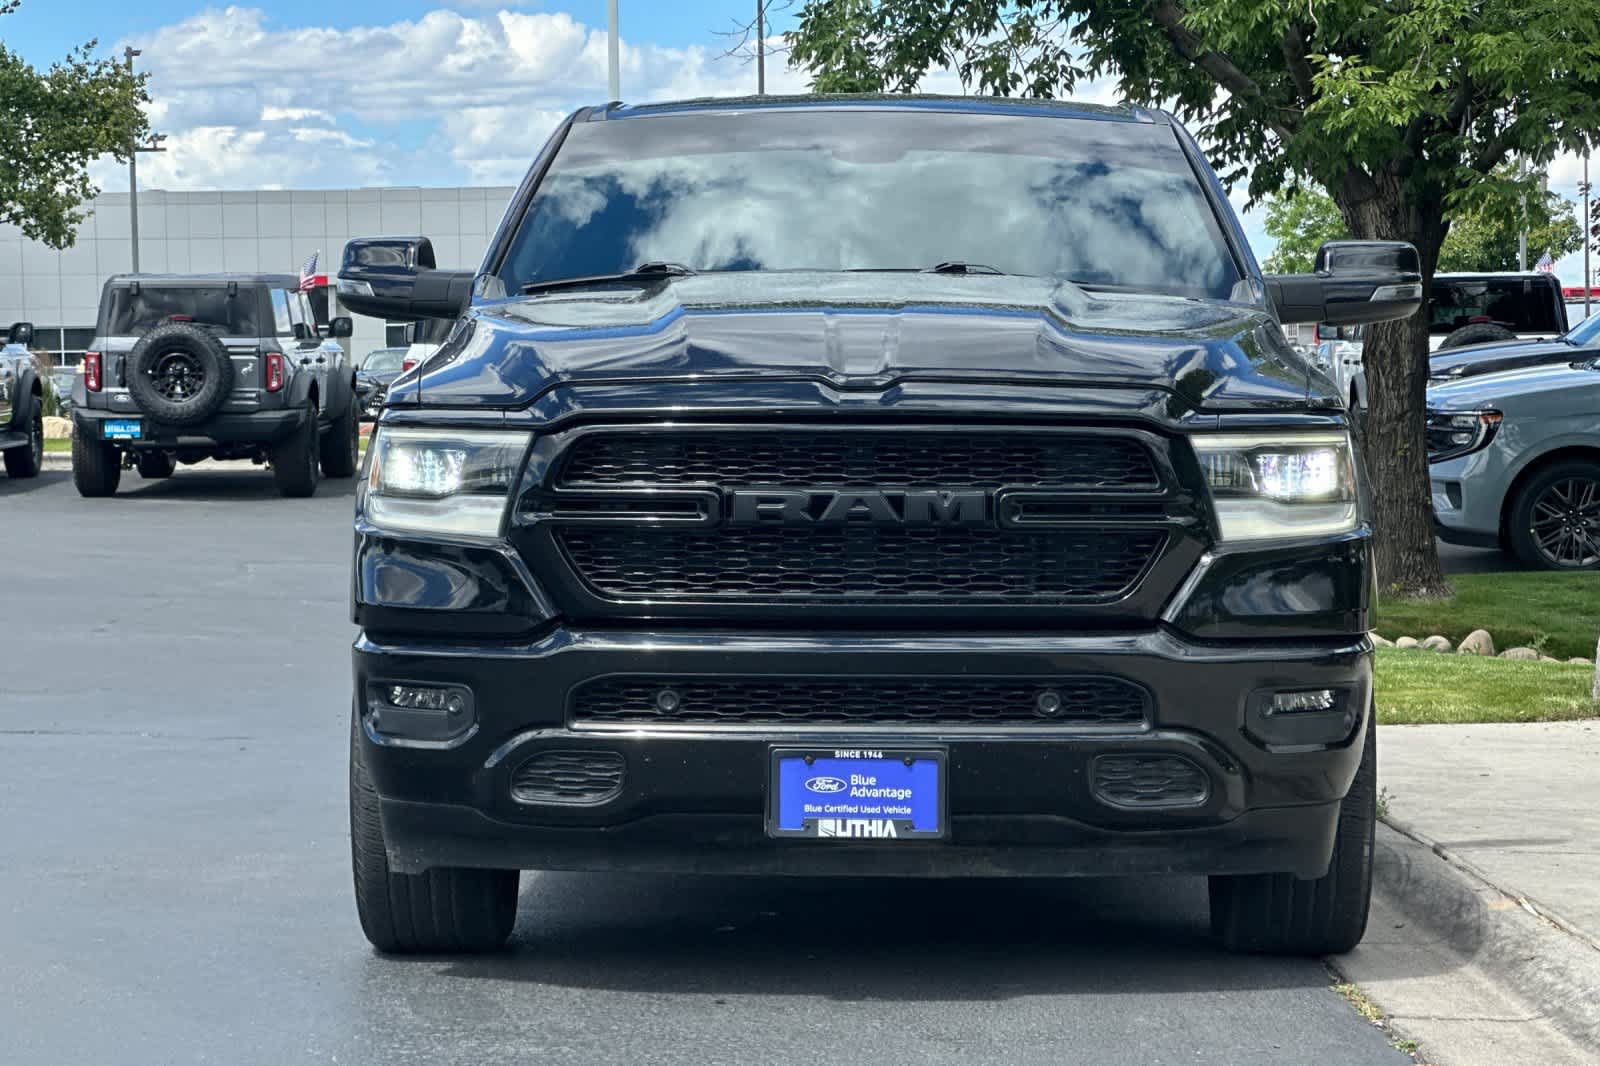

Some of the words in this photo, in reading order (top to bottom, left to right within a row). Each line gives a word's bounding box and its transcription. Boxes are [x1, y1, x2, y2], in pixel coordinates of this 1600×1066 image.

[733, 489, 986, 525] RAM
[834, 751, 860, 759] SINCE
[863, 751, 884, 759] 1946
[812, 777, 840, 791] Ford
[850, 774, 877, 786] Blue
[850, 787, 912, 800] Advantage
[804, 804, 822, 813] Blue
[824, 803, 857, 813] Certified
[860, 805, 881, 813] Used
[883, 805, 911, 815] Vehicle
[836, 819, 897, 837] LITHIA
